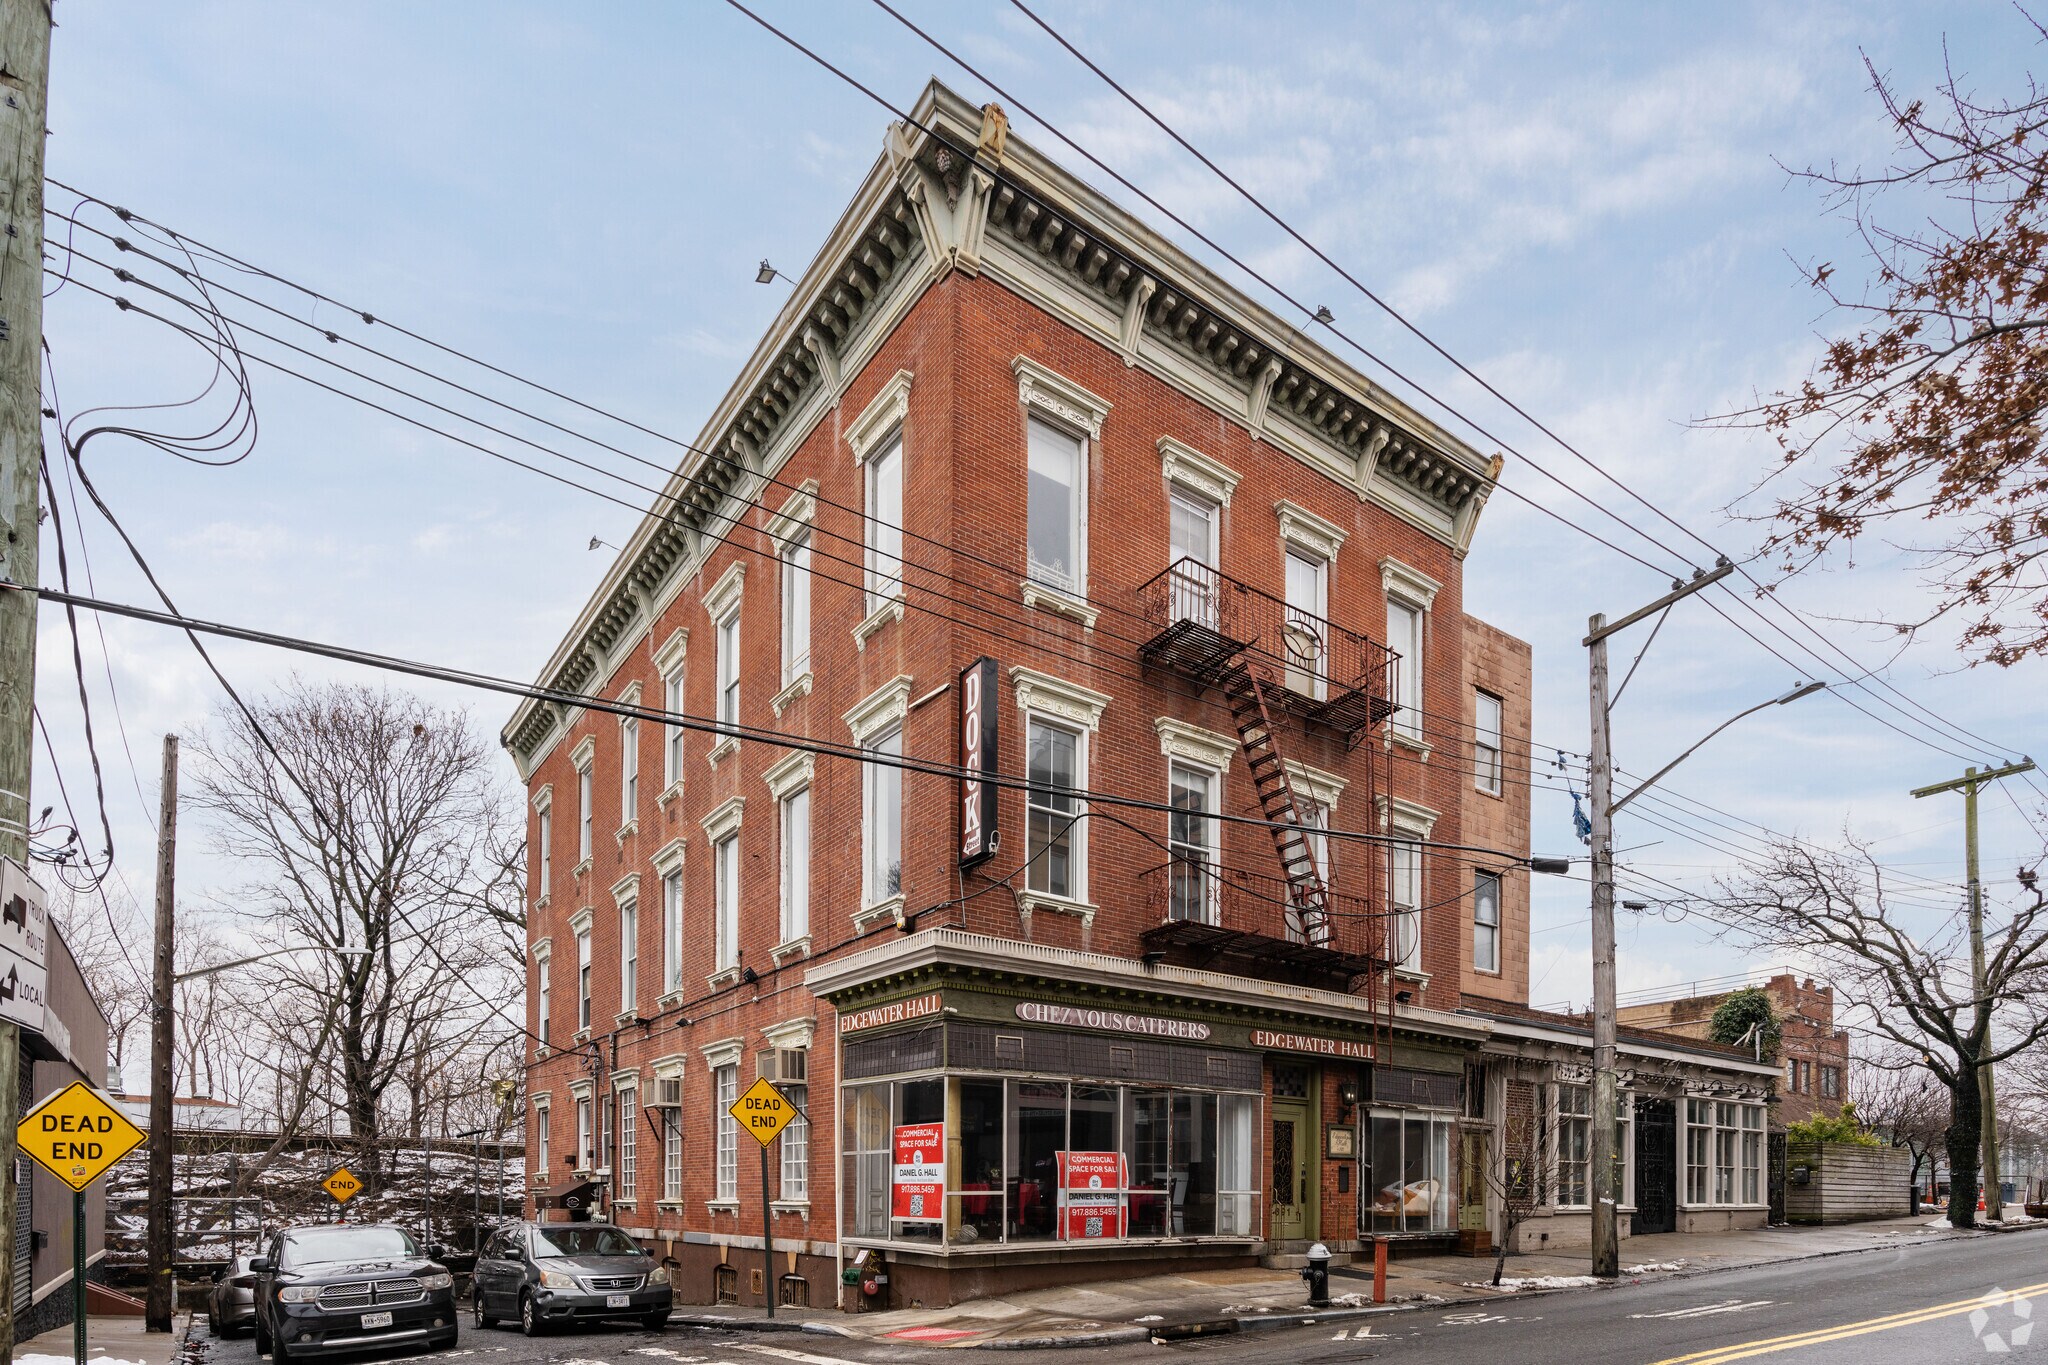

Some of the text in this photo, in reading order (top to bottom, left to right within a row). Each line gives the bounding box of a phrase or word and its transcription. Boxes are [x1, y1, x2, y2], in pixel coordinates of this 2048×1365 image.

[965, 672, 980, 834] DOCK
[28, 898, 46, 926] TRUCK
[26, 929, 44, 956] ROUTE
[19, 981, 44, 1008] LOCAL
[841, 994, 940, 1033] EDGEWATER HALL
[1022, 1002, 1207, 1040] CHEZ VOUS CATERERS
[1256, 1030, 1374, 1059] EDGEWATER HALL
[746, 1098, 781, 1111] DEAD
[42, 1114, 113, 1133] DEAD
[752, 1115, 777, 1128] END
[902, 1128, 935, 1138] COMMERCIAL
[899, 1138, 938, 1148] SPACE FOR SALE
[52, 1142, 103, 1160] END
[1071, 1156, 1114, 1164] COMMERCIAL
[899, 1168, 938, 1177] DANIEL G. HALL
[1069, 1165, 1089, 1173] SPACE
[1089, 1165, 1104, 1173] FOR
[330, 1181, 355, 1190] END
[1072, 1208, 1117, 1216] 917.886.5459
